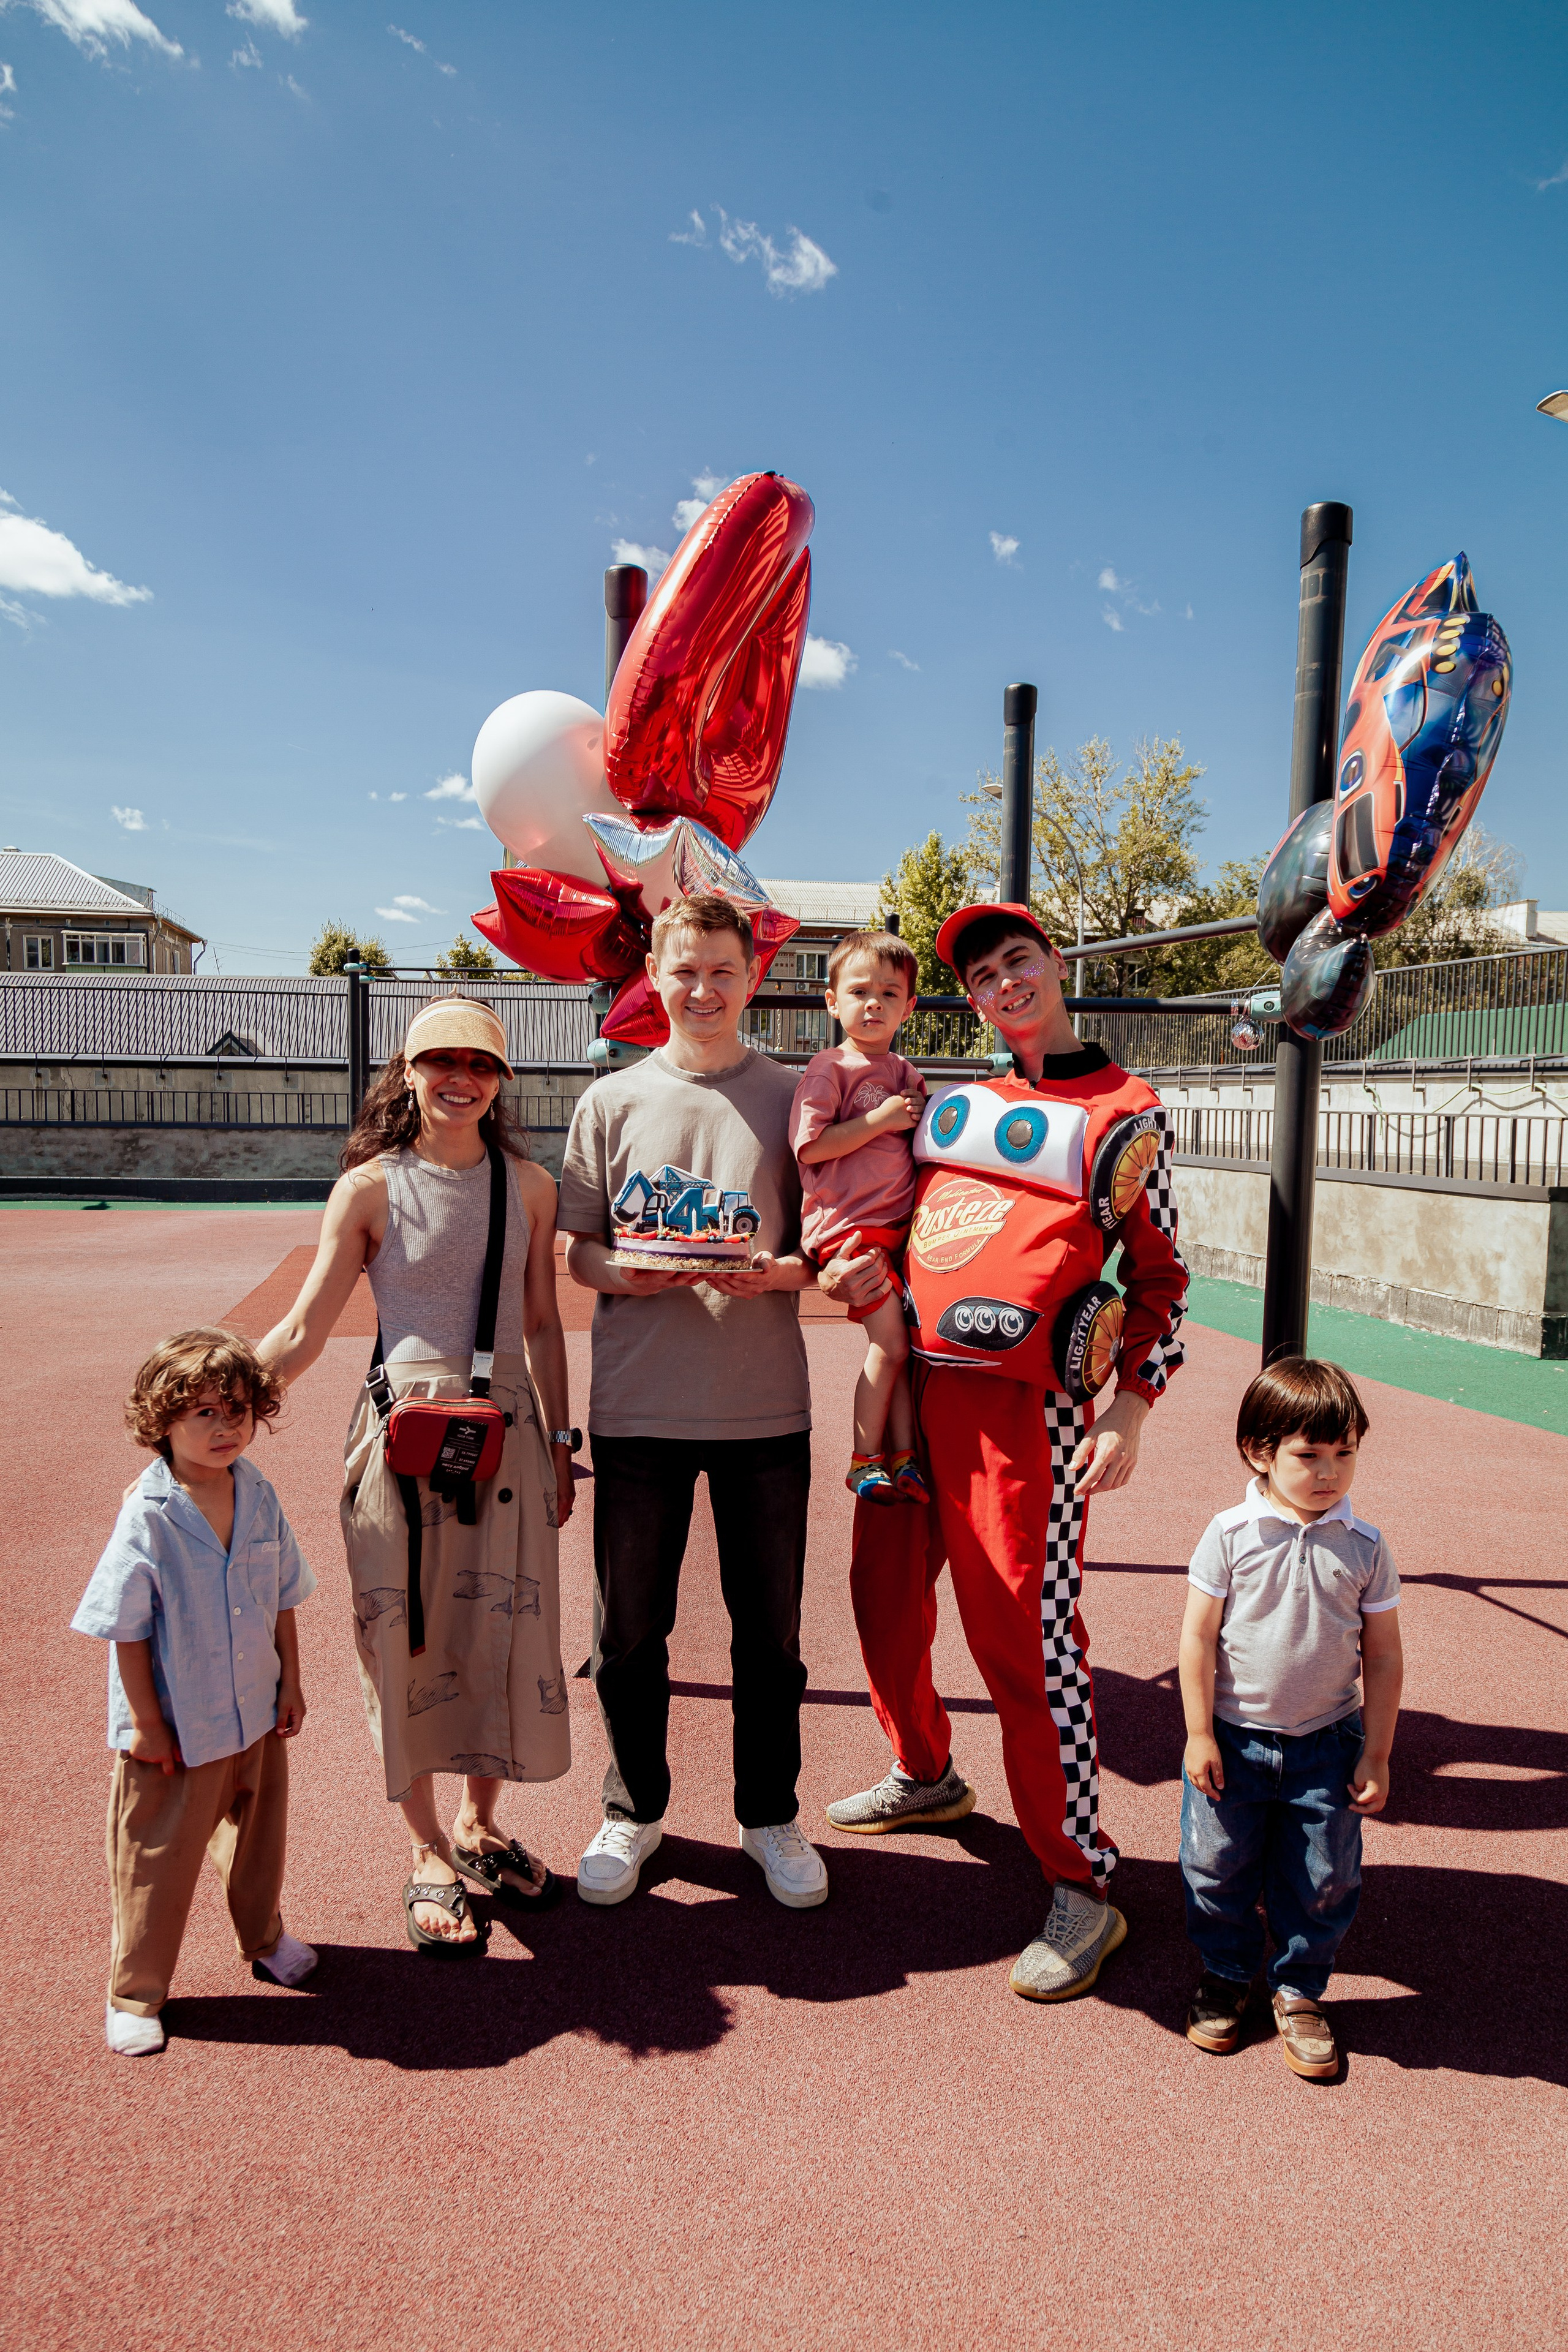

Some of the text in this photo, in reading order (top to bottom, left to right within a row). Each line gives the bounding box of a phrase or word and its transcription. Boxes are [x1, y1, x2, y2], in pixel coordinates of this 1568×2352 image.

[937, 1187, 986, 1202] Medicated
[666, 1188, 709, 1234] 4
[924, 1225, 993, 1249] BUMPER OINTMENT
[927, 1254, 939, 1263] REAR
[955, 1239, 981, 1260] FORMULA
